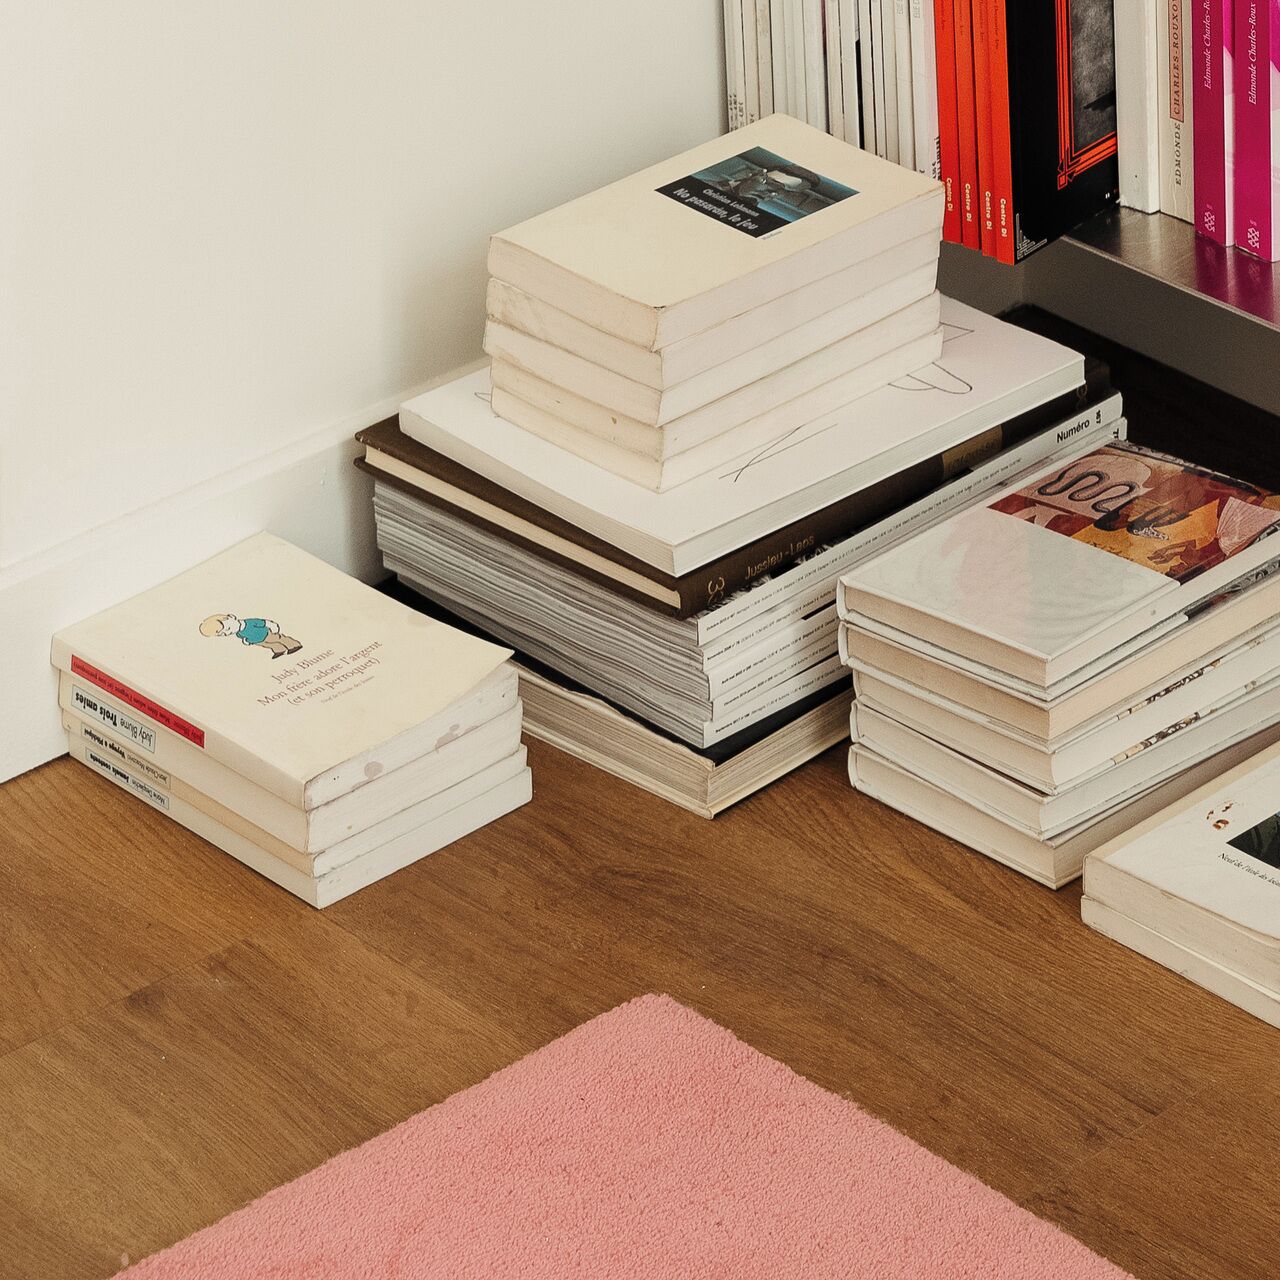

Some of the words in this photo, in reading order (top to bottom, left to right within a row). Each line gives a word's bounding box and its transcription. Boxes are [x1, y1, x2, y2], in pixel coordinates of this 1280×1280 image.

[1247, 2, 1257, 62] Charles-Roux
[1204, 47, 1212, 90] Edmonde
[1248, 62, 1257, 105] Edmonde
[1174, 123, 1182, 187] EDMONDE
[673, 187, 690, 199] No
[728, 213, 742, 223] le
[736, 218, 760, 230] jeu
[702, 188, 731, 204] Christian
[1056, 419, 1091, 444] Numéro
[256, 689, 288, 707] Mon
[286, 678, 314, 694] frère
[313, 662, 344, 681] adore
[271, 667, 300, 685] Judy
[296, 648, 334, 670] Blume
[305, 686, 327, 699] son
[324, 656, 381, 690] perroquet)
[75, 691, 99, 713] amies
[99, 707, 118, 728] Trois
[119, 717, 139, 740] Blume
[138, 726, 154, 747] Judy
